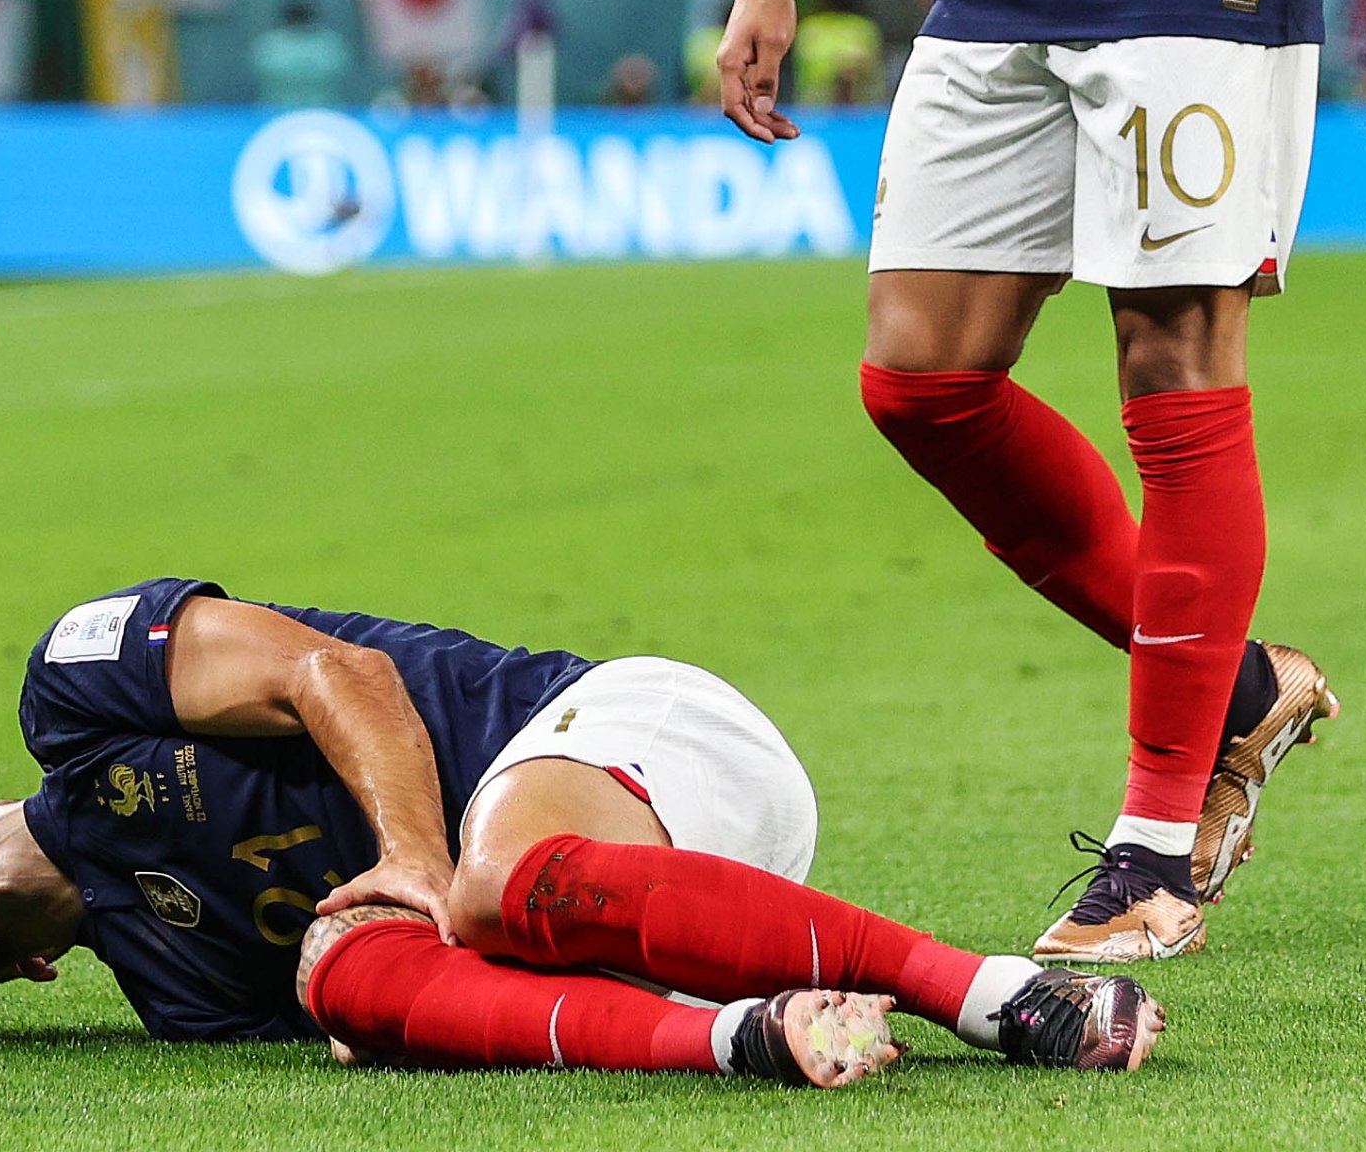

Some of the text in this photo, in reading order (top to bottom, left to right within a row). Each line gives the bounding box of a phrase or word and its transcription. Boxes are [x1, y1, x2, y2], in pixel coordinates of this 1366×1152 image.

[1117, 103, 1236, 211] 10
[395, 134, 857, 258] WANDA
[174, 749, 187, 785] AUSTRALIE
[184, 744, 195, 767] 2022
